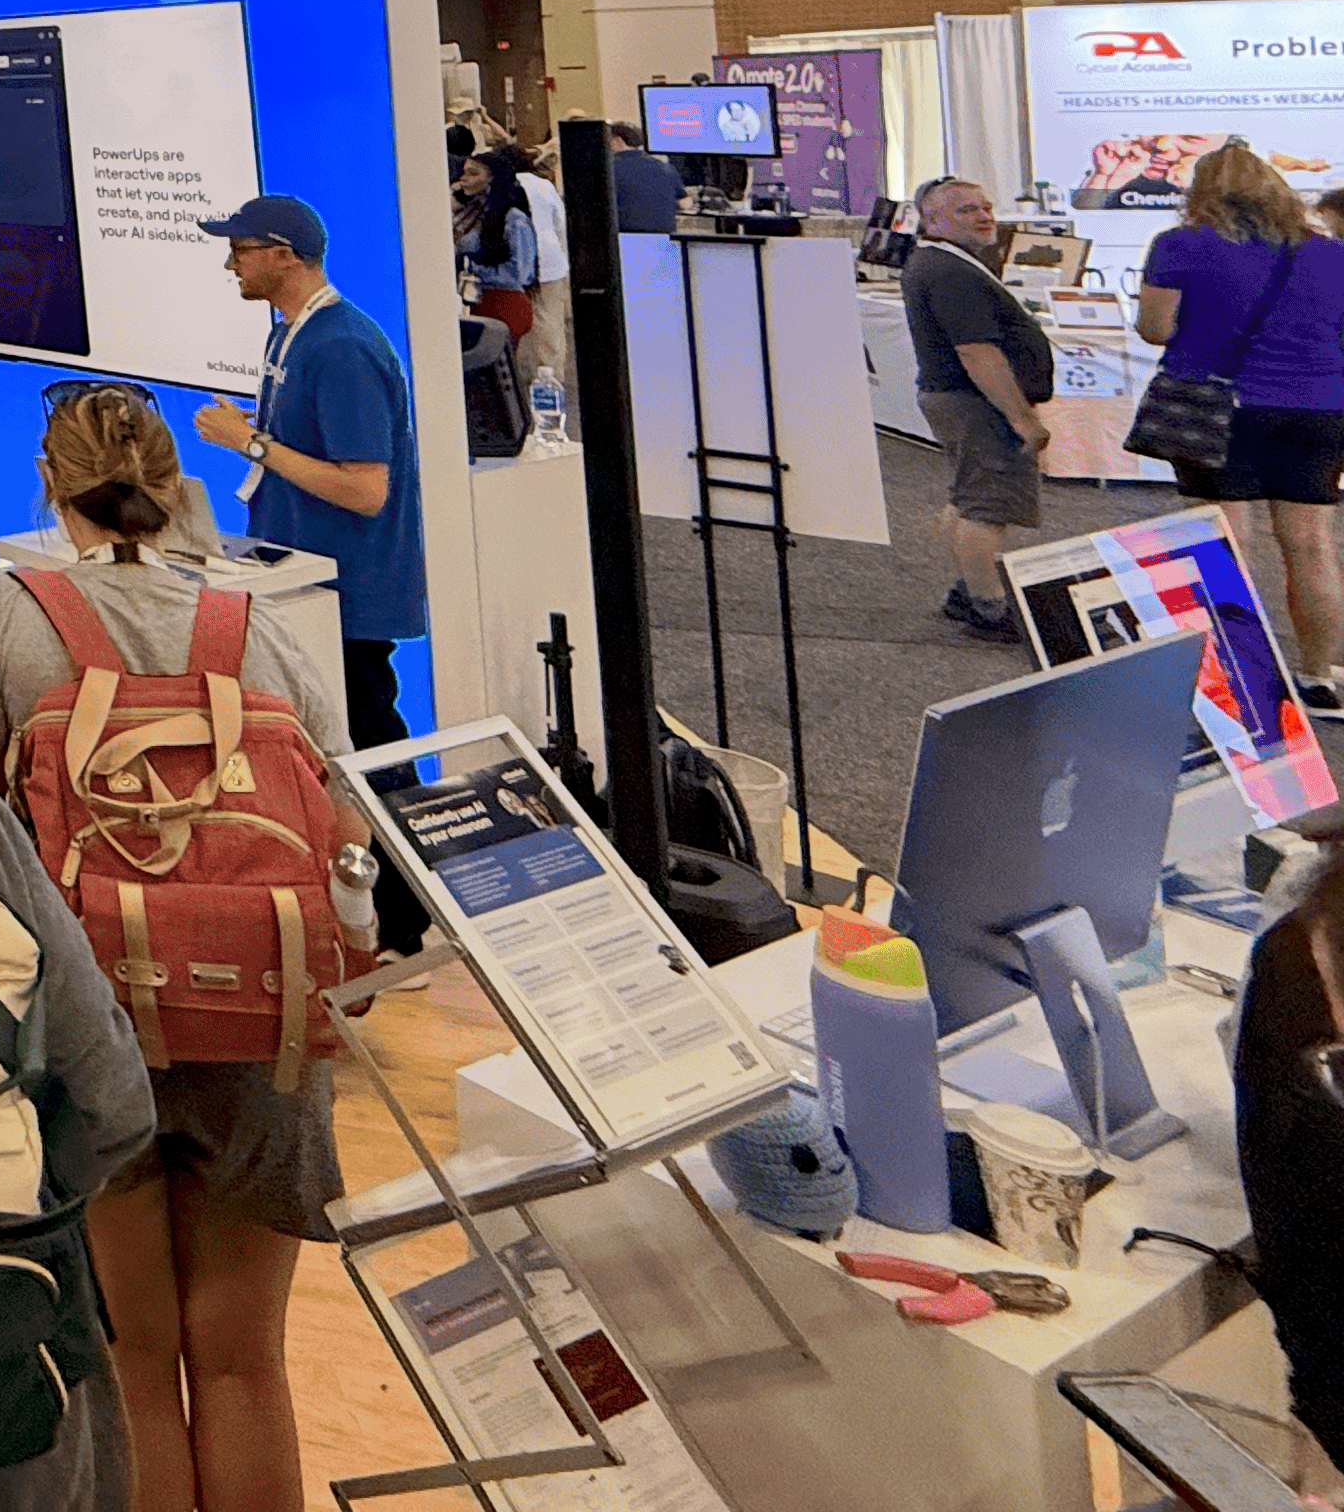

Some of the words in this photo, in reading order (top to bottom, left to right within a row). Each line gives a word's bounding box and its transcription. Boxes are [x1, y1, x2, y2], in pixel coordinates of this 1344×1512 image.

[1232, 36, 1344, 59] Proble
[1063, 96, 1140, 107] HEADSETS
[1153, 95, 1260, 106] HEADPHONES
[92, 147, 160, 163] PowerUps
[162, 150, 185, 162] are
[94, 166, 165, 181] interactive
[167, 170, 202, 185] apps
[96, 186, 122, 199] that
[125, 188, 142, 200] let
[145, 191, 169, 204] you
[172, 190, 212, 206] work,
[98, 206, 143, 221] create,
[146, 208, 170, 220] and
[173, 209, 201, 224] play
[100, 226, 128, 239] your
[131, 227, 145, 239] AI
[148, 228, 210, 244] sidekick.
